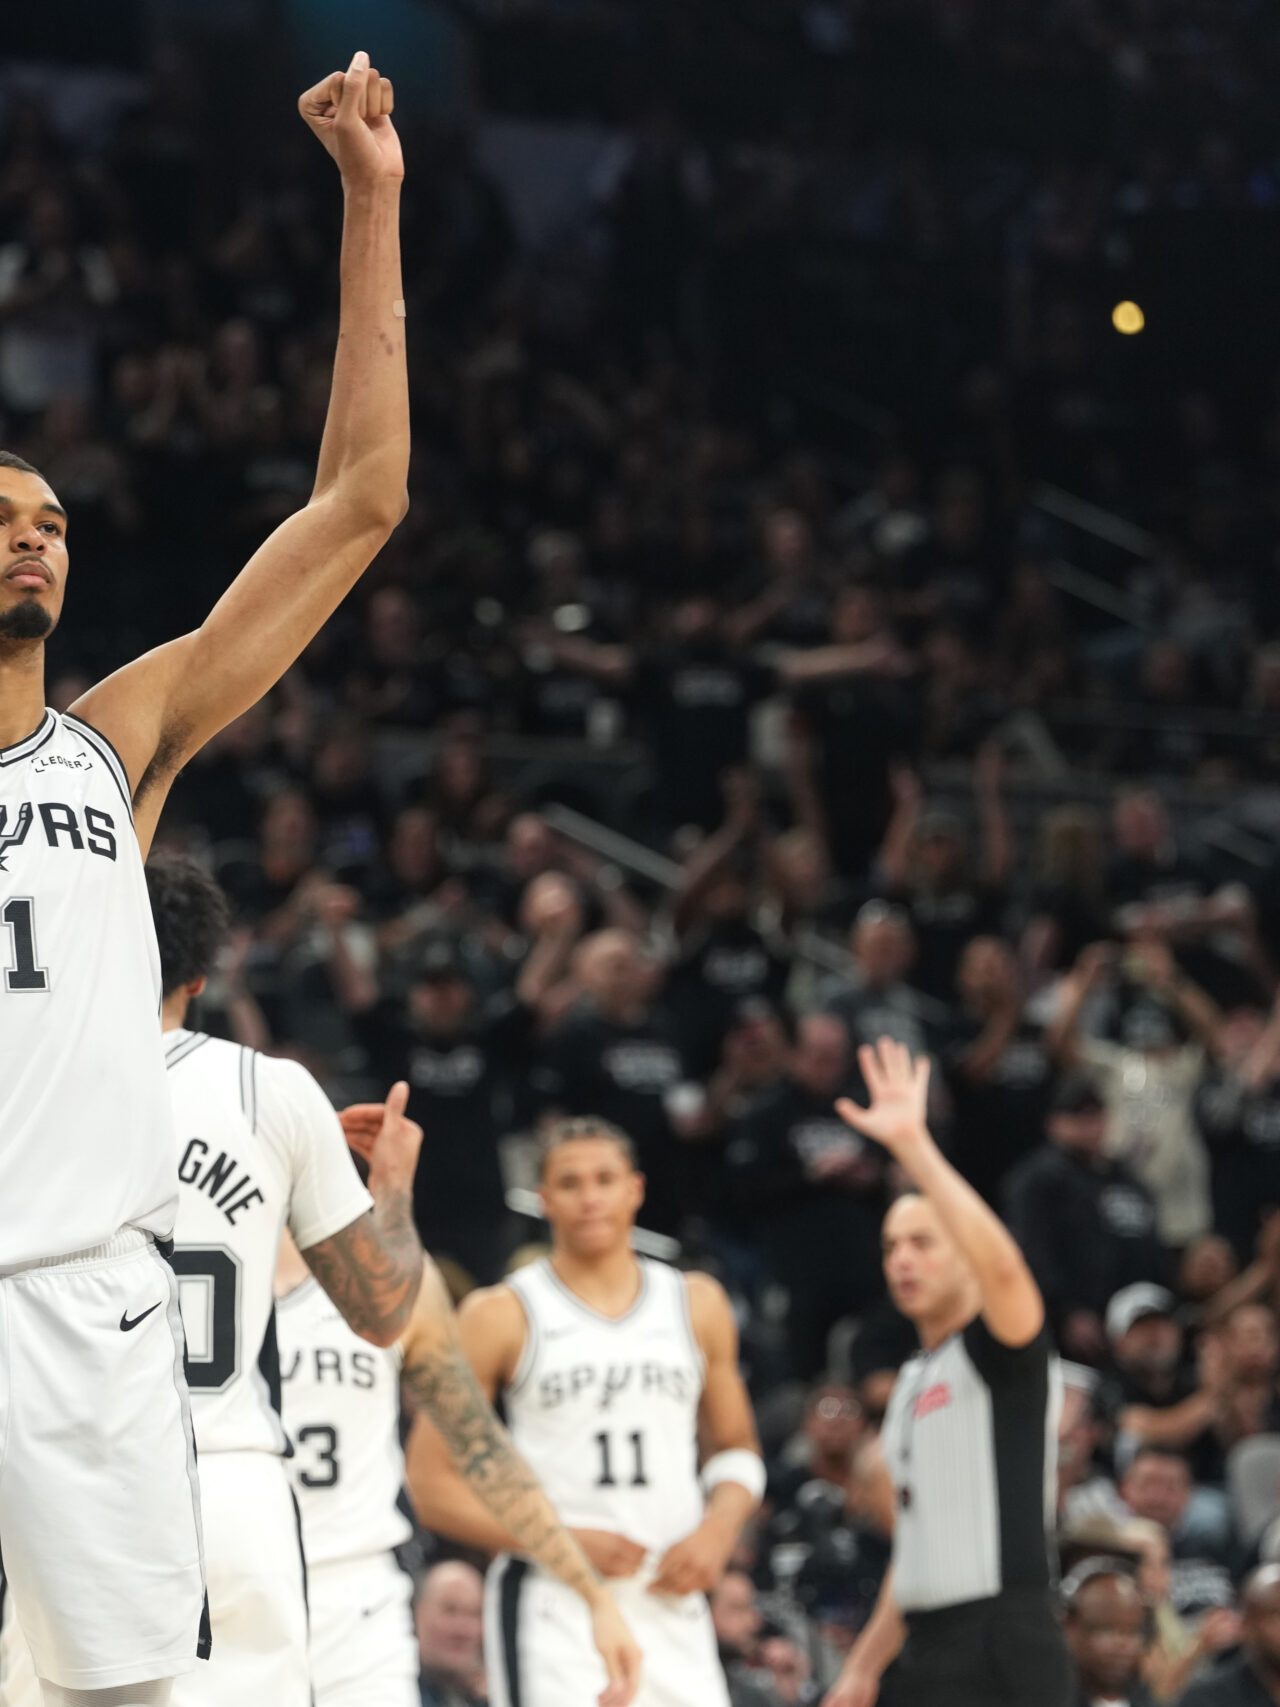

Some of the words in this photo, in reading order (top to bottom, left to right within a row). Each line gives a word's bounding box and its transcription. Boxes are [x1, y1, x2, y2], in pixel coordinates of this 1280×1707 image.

[0, 896, 51, 994] 1
[539, 1361, 692, 1413] SPURS
[296, 1423, 339, 1488] 3
[593, 1429, 649, 1488] 11
